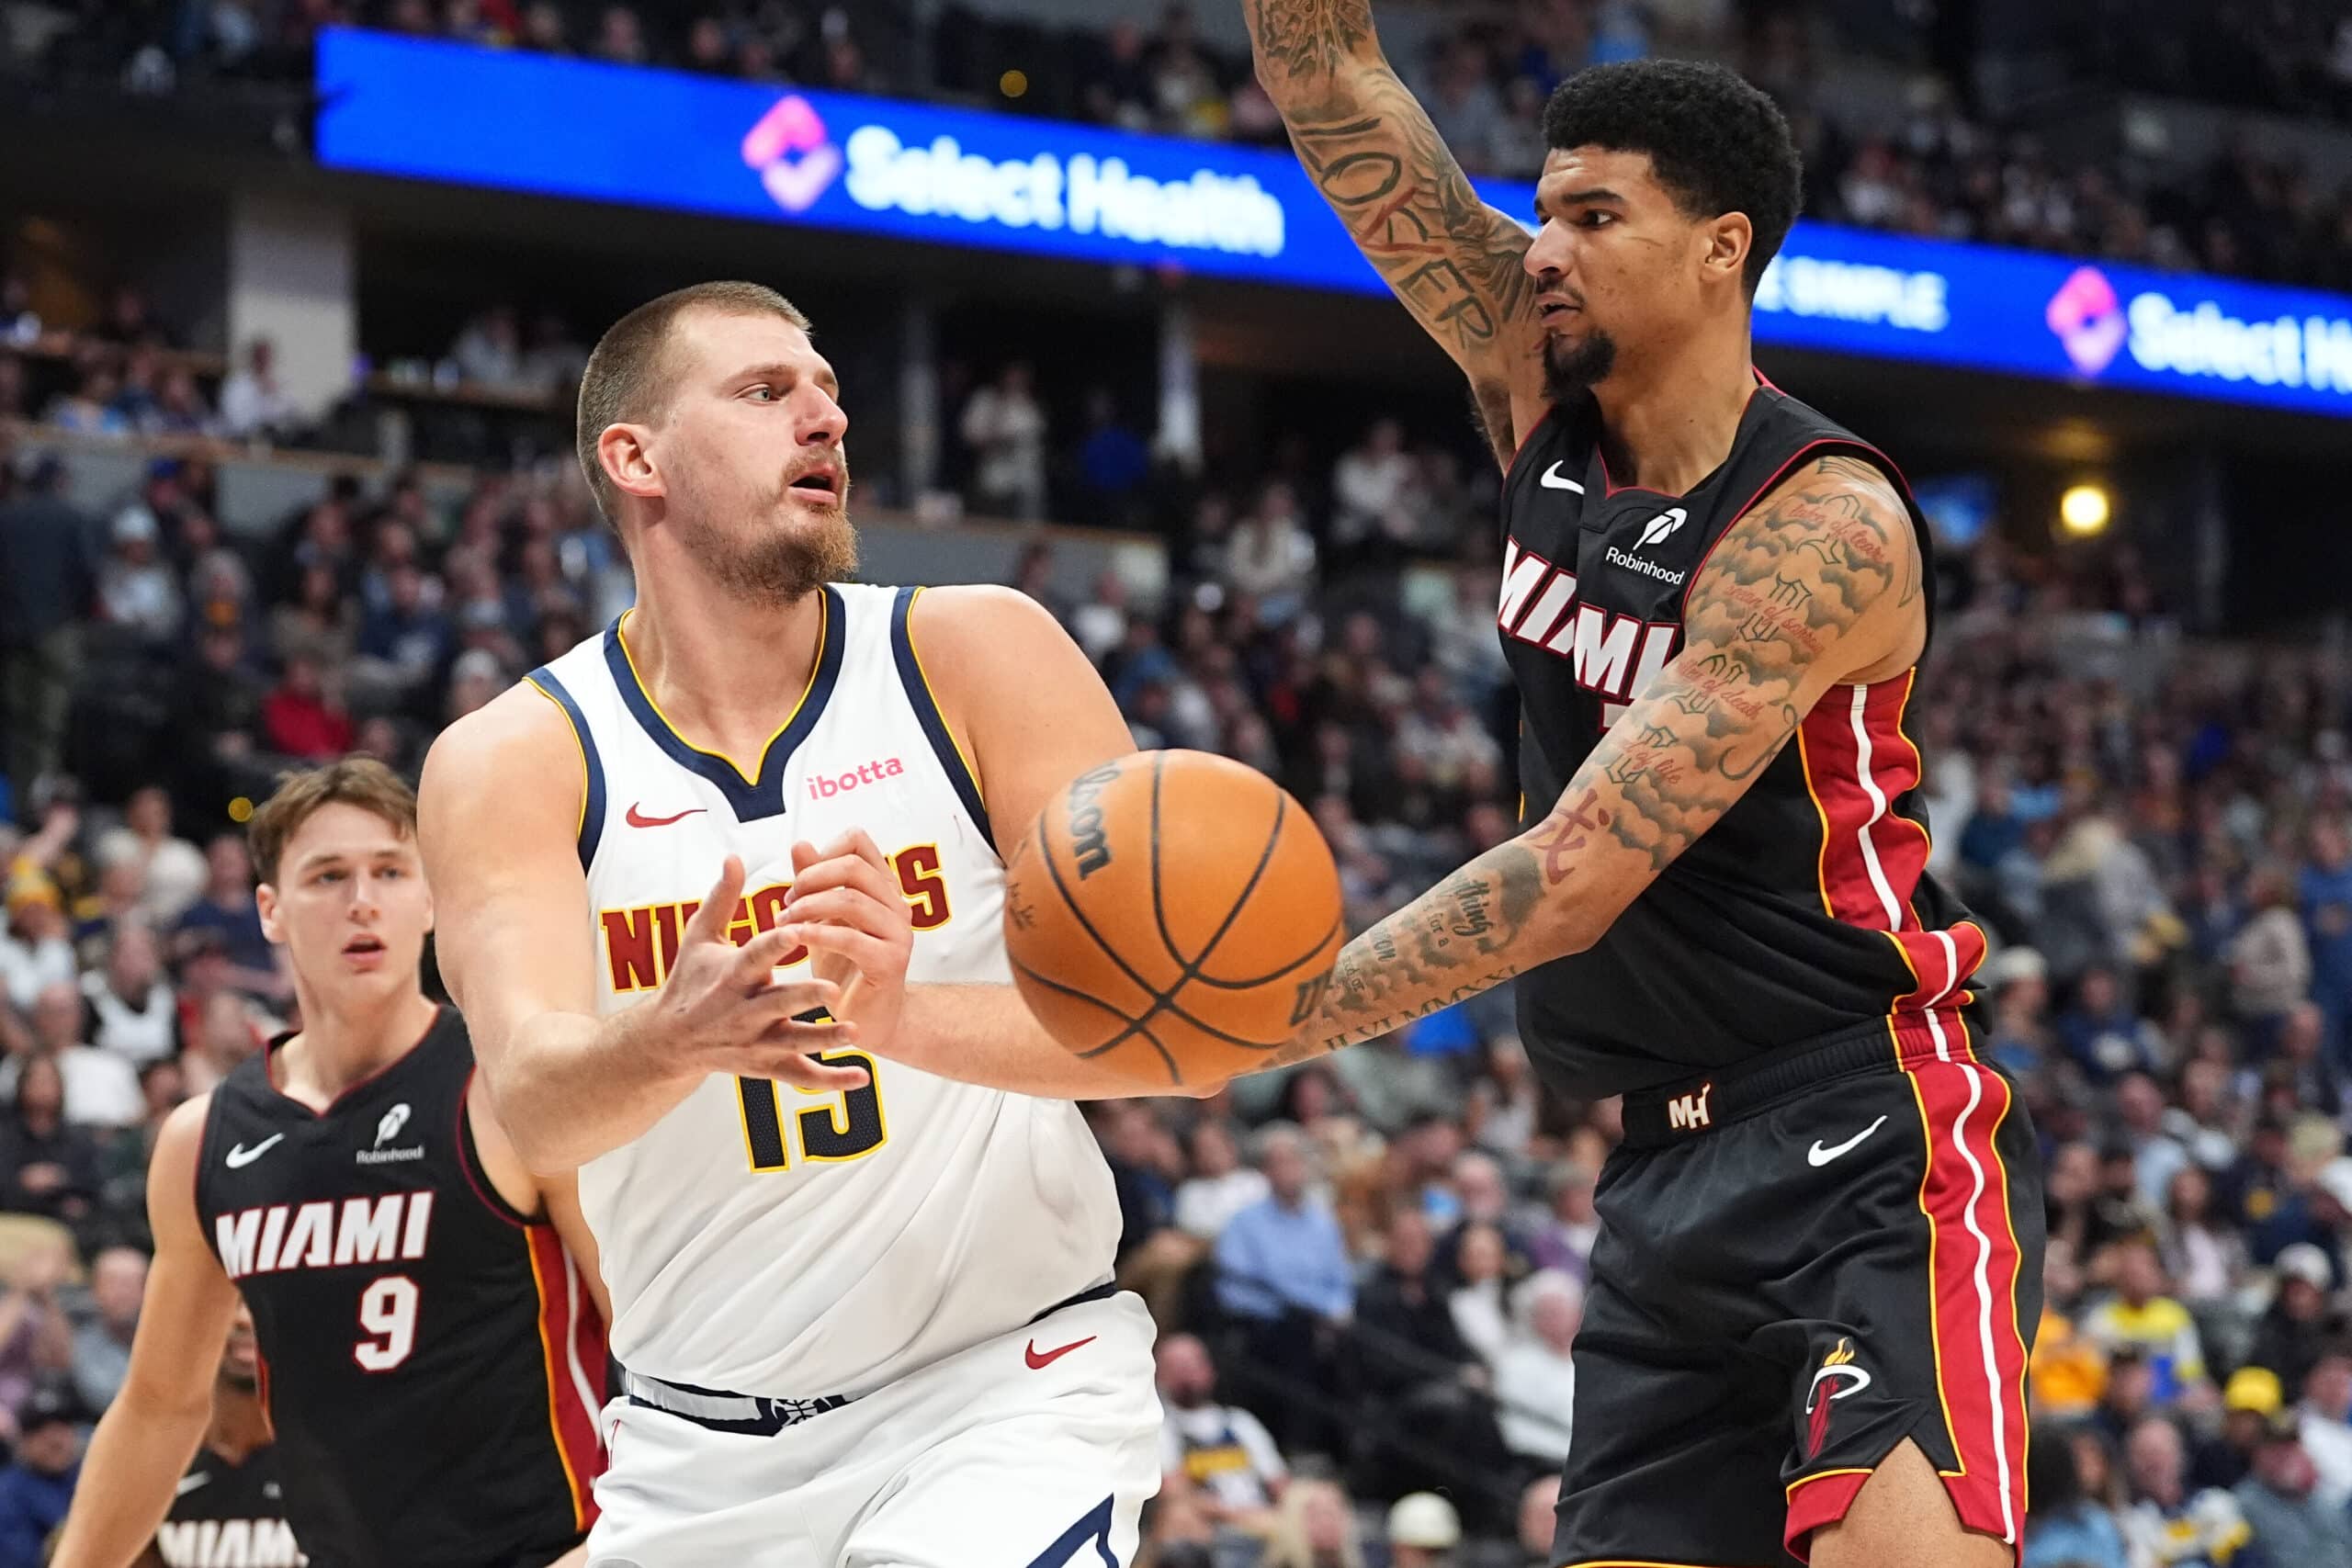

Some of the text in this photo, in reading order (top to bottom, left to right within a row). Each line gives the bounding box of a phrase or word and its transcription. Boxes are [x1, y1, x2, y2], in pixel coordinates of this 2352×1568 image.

[846, 125, 1285, 258] Select Health
[2128, 291, 2304, 389] Select
[1605, 547, 1685, 586] Robinhood
[808, 756, 905, 802] ibotta
[736, 1007, 888, 1174] 15
[356, 1145, 424, 1166] Robinhood
[214, 1189, 435, 1281] MIAMI
[353, 1274, 420, 1372] 9
[156, 1517, 310, 1568] MIAM
